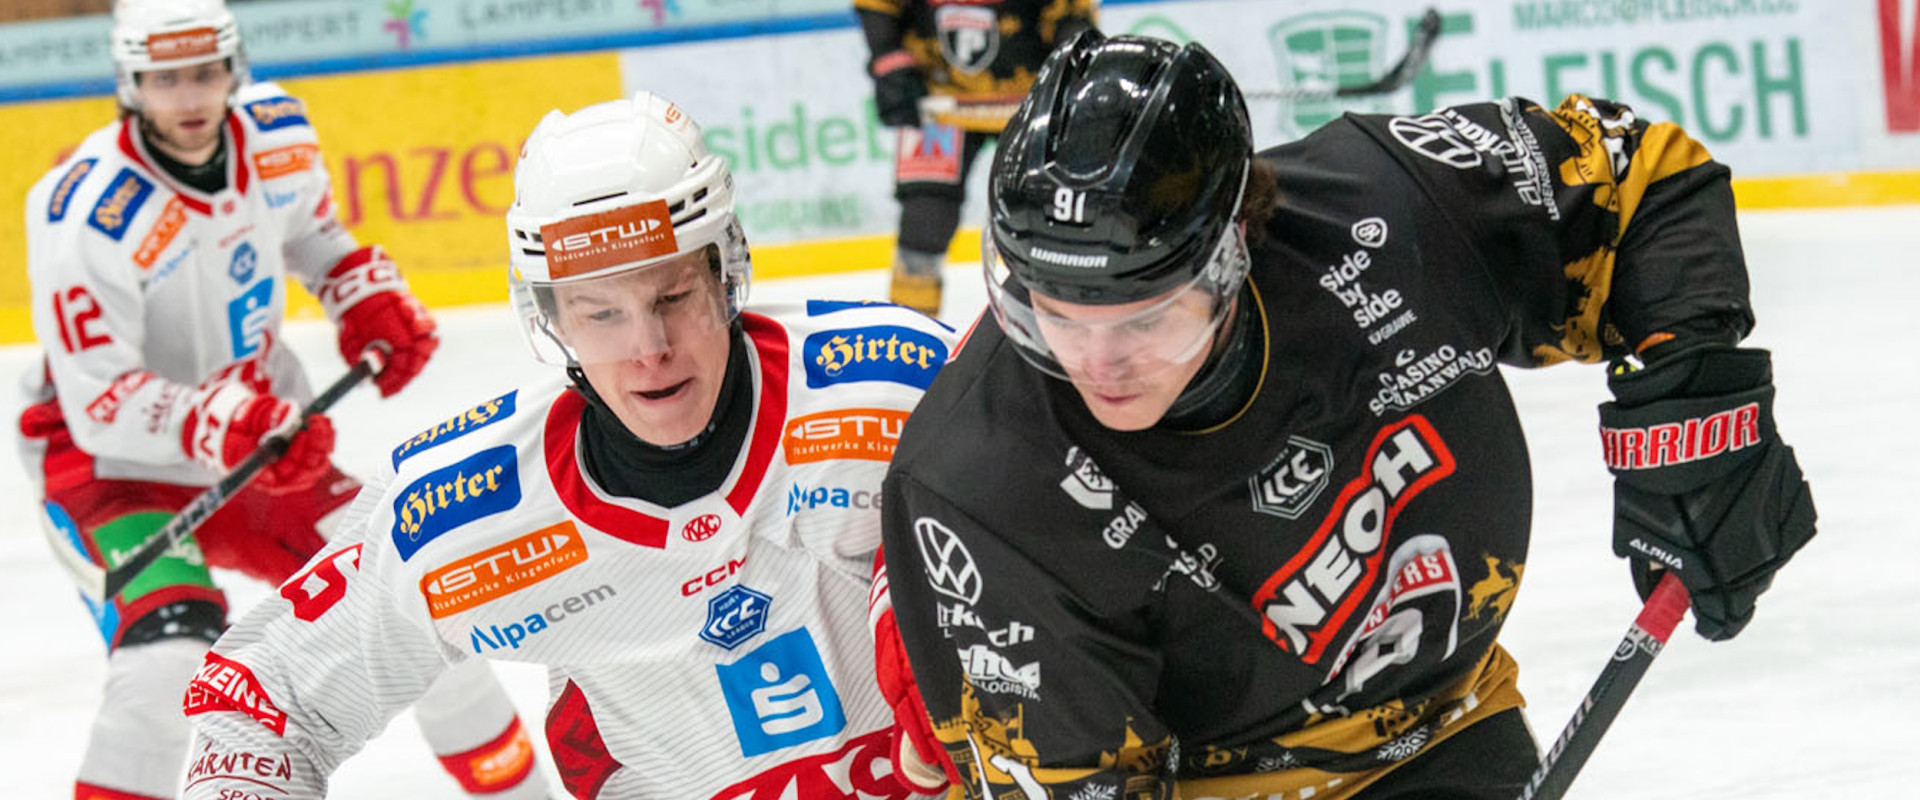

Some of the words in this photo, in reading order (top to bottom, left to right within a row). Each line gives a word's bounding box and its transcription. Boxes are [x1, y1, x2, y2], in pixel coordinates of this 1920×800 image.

[1053, 187, 1087, 223] 91
[562, 219, 648, 251] STW
[1031, 247, 1109, 268] WARRIOR
[1319, 250, 1371, 292] side
[1333, 283, 1368, 308] by
[1353, 289, 1403, 328] side
[53, 286, 113, 353] 12
[816, 334, 937, 377] Hirter
[1601, 402, 1761, 470] ARRIOR
[400, 465, 502, 542] Hirter
[683, 515, 720, 541] KAC
[1102, 501, 1148, 550] GRA
[1264, 428, 1433, 656] NEOH
[441, 536, 552, 593] STW
[1629, 538, 1683, 570] ALPHA
[433, 581, 500, 611] Stadtwerke
[505, 549, 578, 584] Klagenfurt
[682, 556, 747, 597] CCM
[470, 584, 617, 654] Alpacem
